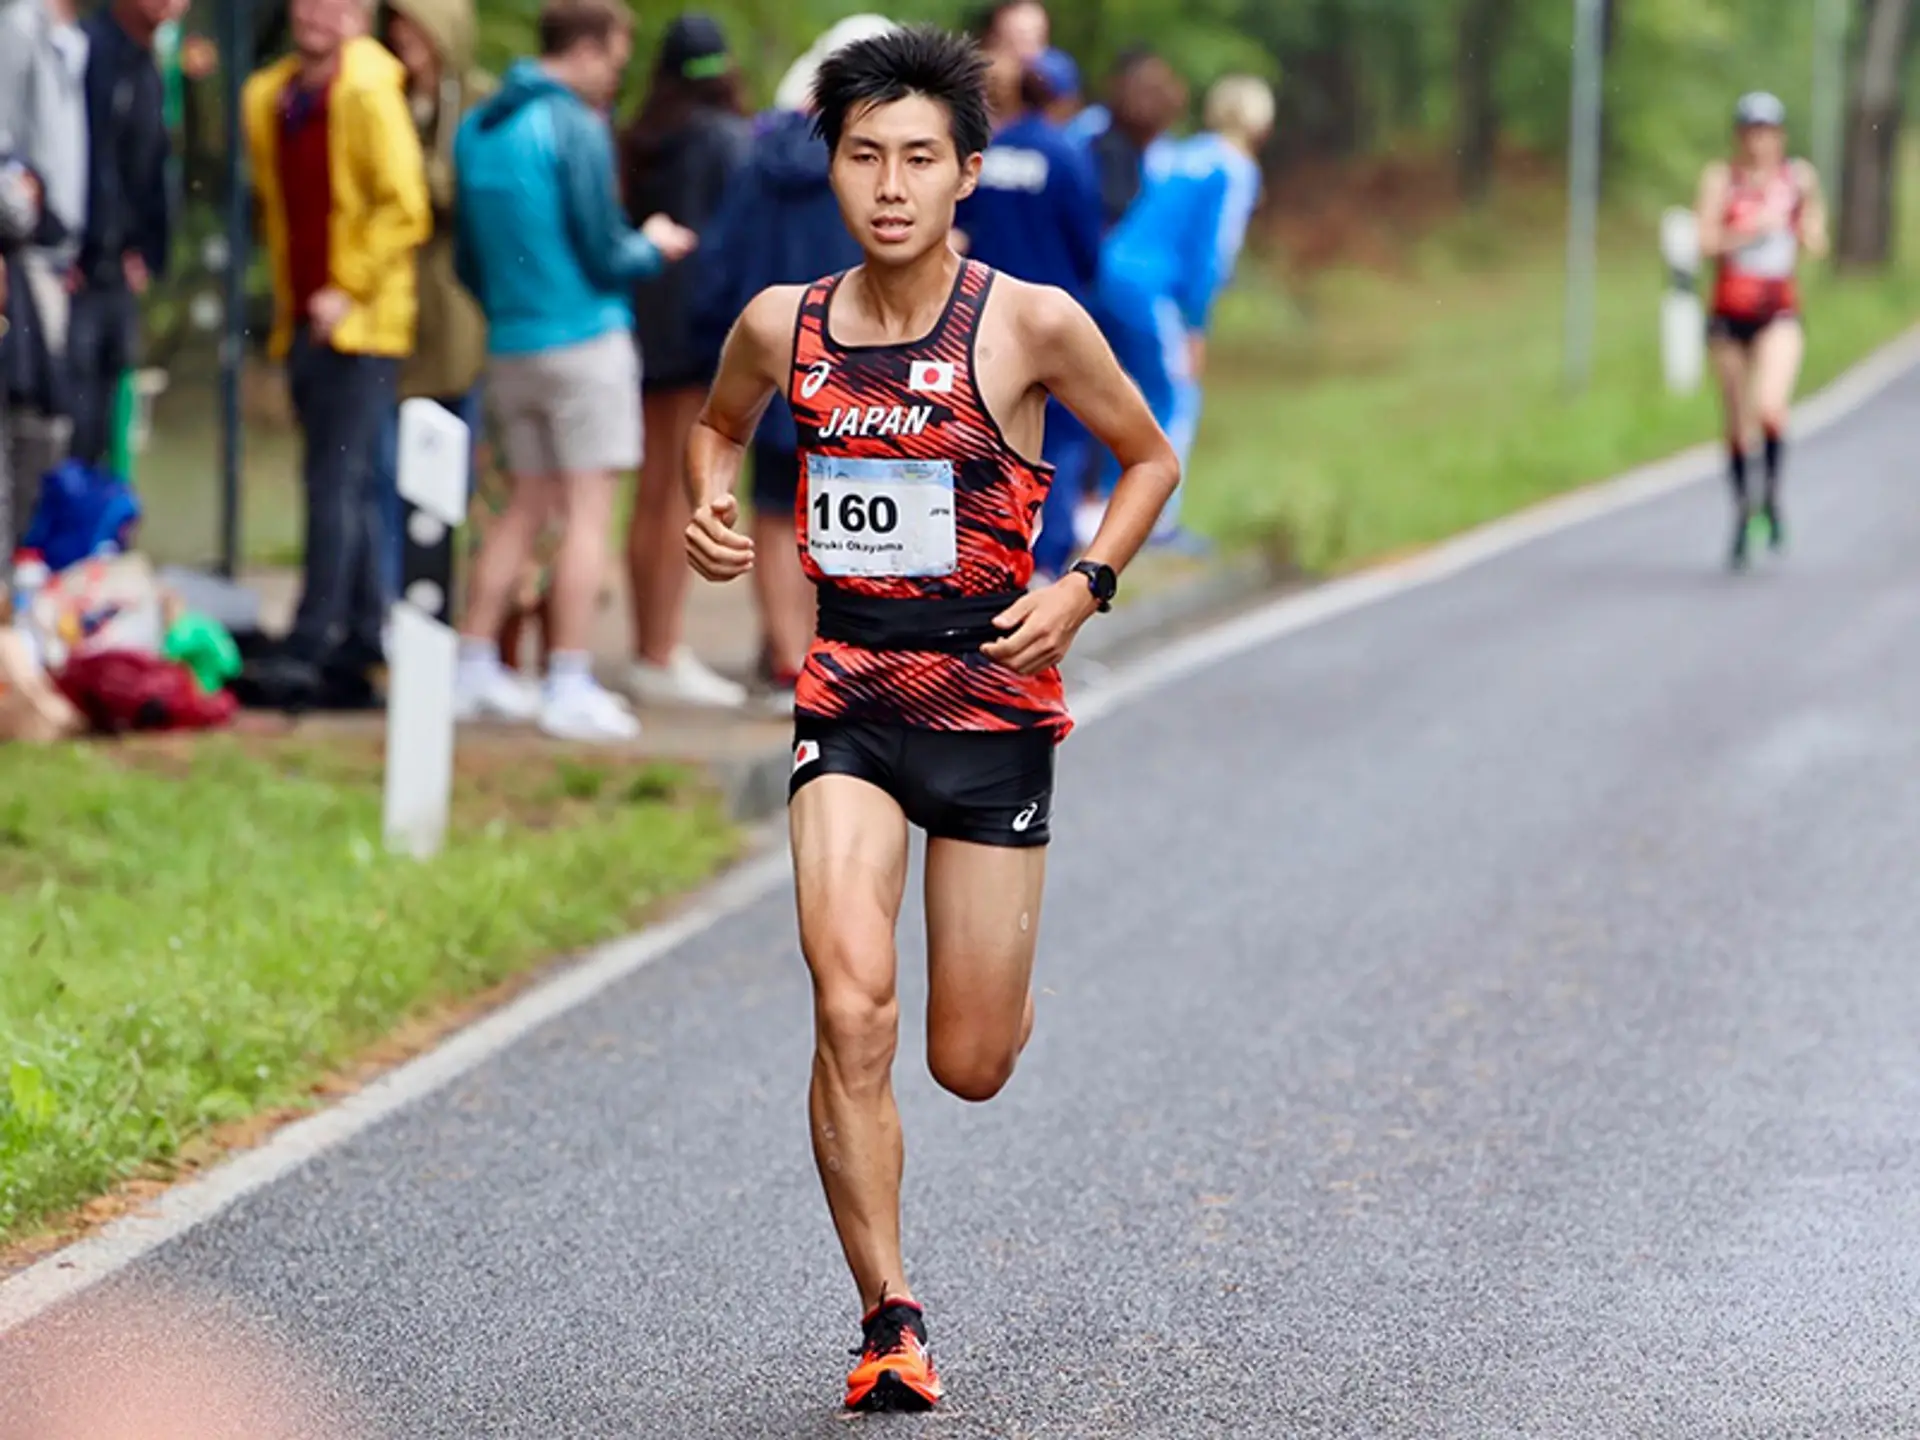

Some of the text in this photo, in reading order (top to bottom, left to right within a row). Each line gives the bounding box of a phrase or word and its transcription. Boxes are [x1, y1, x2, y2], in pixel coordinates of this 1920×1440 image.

[818, 405, 933, 438] JAPAN
[813, 492, 898, 534] 160
[846, 540, 904, 554] Okayama
